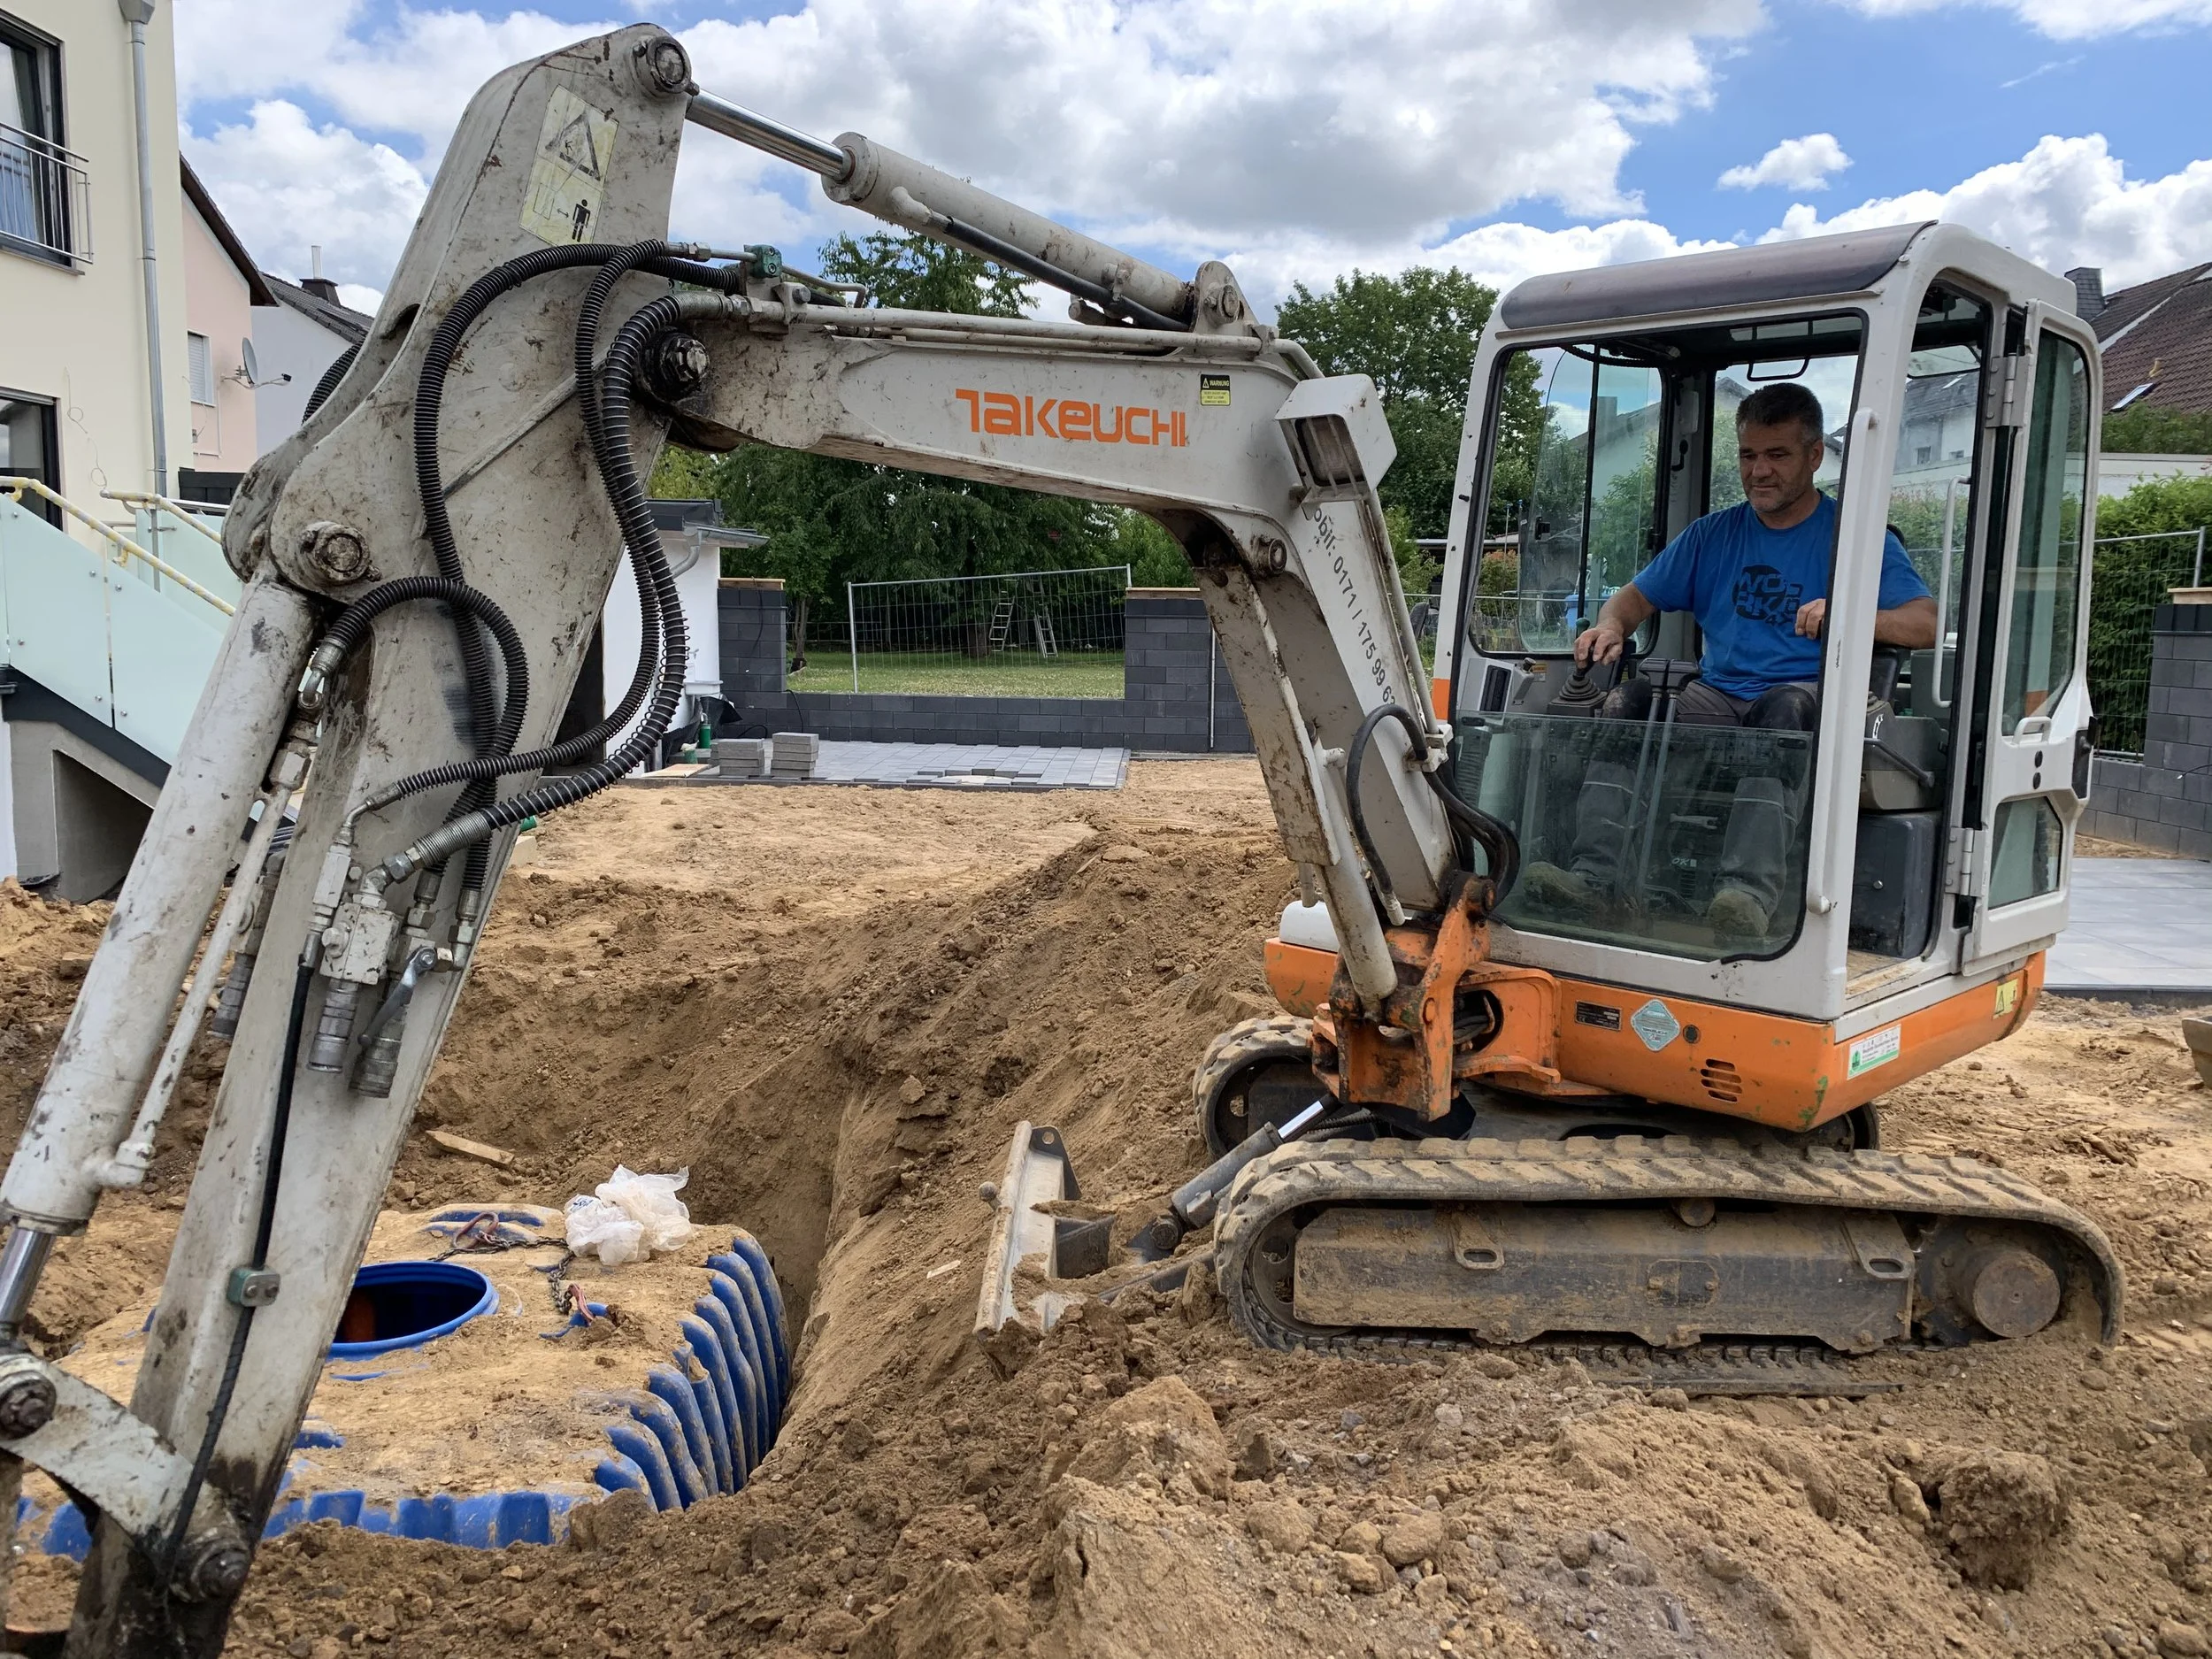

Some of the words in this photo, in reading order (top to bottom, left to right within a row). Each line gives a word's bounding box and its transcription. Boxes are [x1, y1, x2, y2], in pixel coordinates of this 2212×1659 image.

[1314, 508, 1336, 557] obil:
[1333, 556, 1357, 609] 0171
[1357, 621, 1379, 660] 175
[1371, 658, 1386, 687] 99
